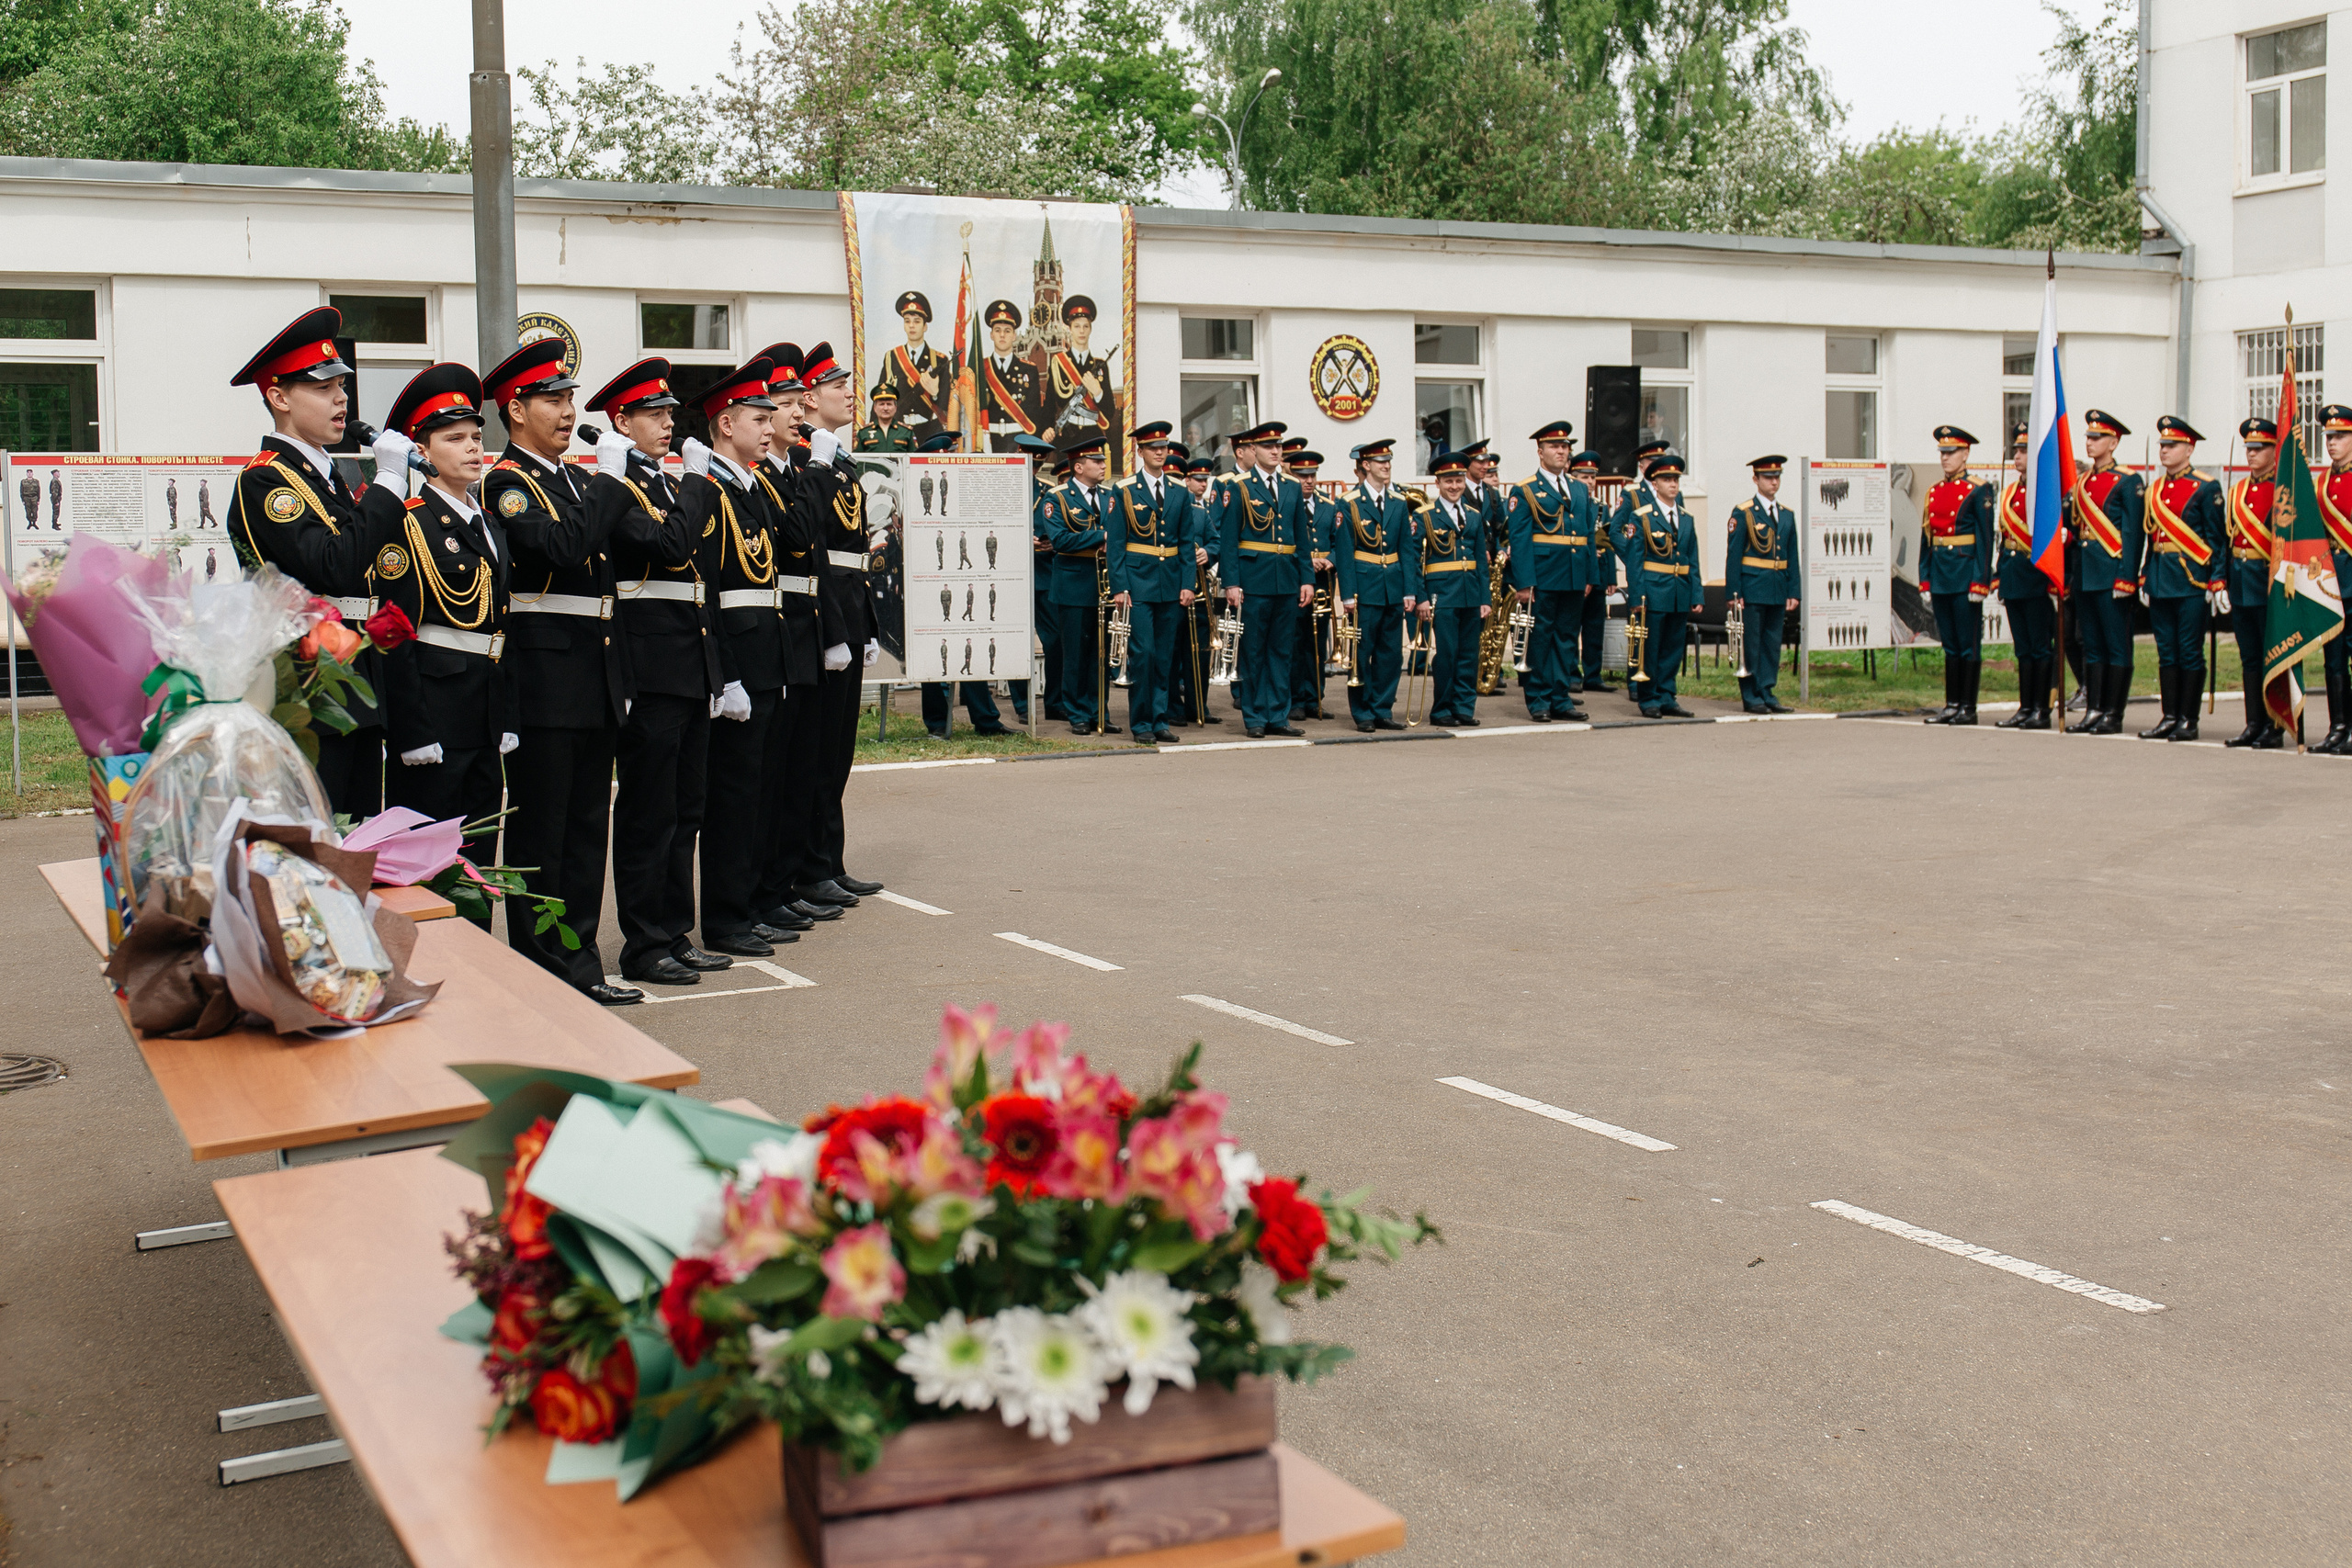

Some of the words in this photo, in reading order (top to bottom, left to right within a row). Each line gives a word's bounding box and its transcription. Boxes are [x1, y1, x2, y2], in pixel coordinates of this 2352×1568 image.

[1335, 400, 1357, 410] 2001
[63, 456, 104, 464] СТРОЕВАЯ
[141, 456, 184, 464] ПОВОРОТЫ
[186, 456, 197, 464] НА
[198, 456, 224, 464] МЕСТЕ
